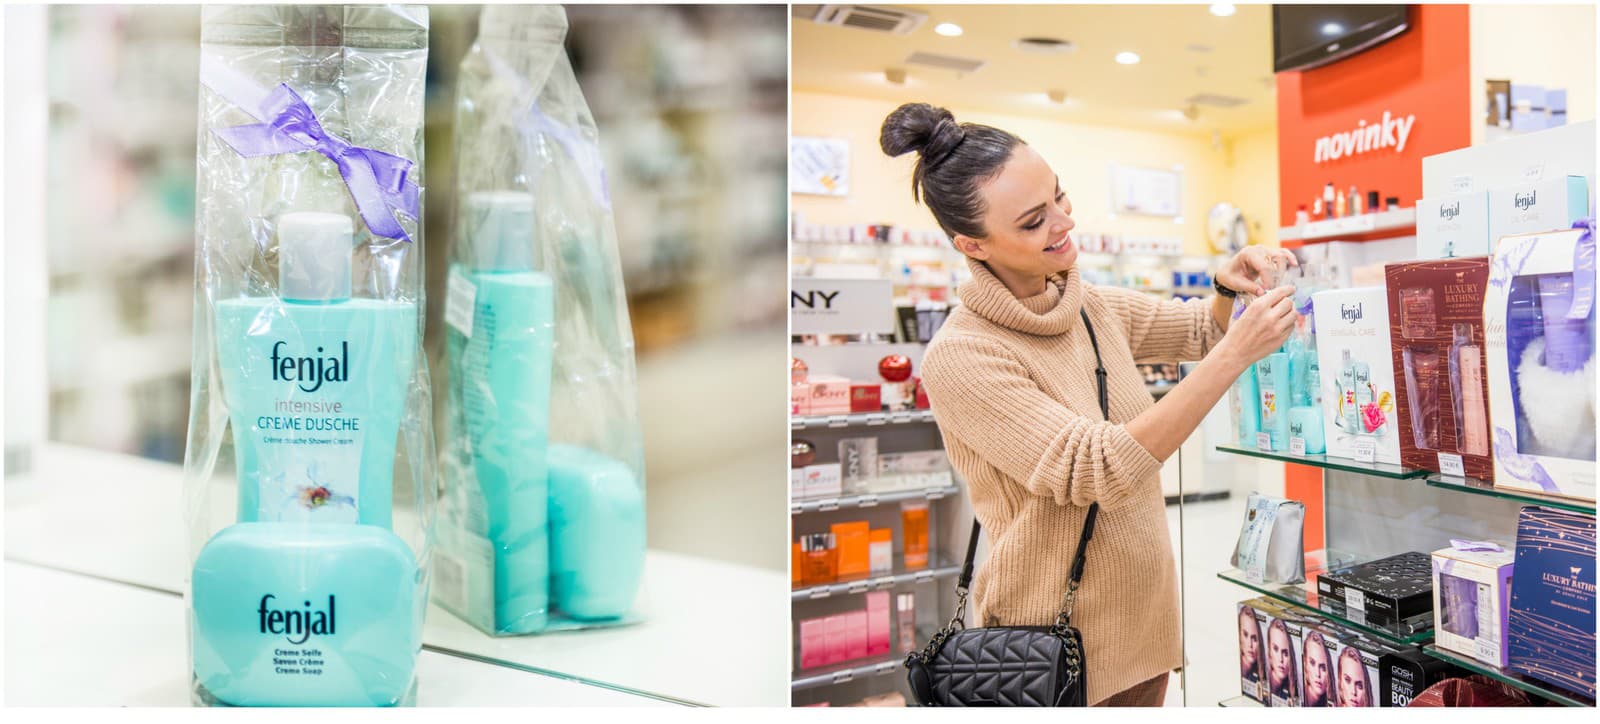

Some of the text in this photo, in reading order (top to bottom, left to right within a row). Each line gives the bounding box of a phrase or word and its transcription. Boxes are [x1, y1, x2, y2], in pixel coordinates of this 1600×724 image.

[1314, 110, 1415, 163] novinky
[1514, 189, 1536, 211] fenjal
[1440, 200, 1460, 221] fenjal
[1444, 284, 1478, 294] LUXURY
[791, 290, 840, 309] NY
[1445, 294, 1480, 303] BATHING
[1341, 302, 1363, 324] fenjal
[1359, 327, 1377, 337] CARE
[270, 340, 348, 393] fenjal
[275, 398, 343, 414] intensive
[257, 416, 360, 431] CREME DUSCHE
[1543, 572, 1571, 586] LUXURY
[257, 593, 336, 645] fenjal
[302, 667, 323, 675] Soap
[1391, 665, 1414, 679] GOSH
[1391, 682, 1414, 697] BEAUTY
